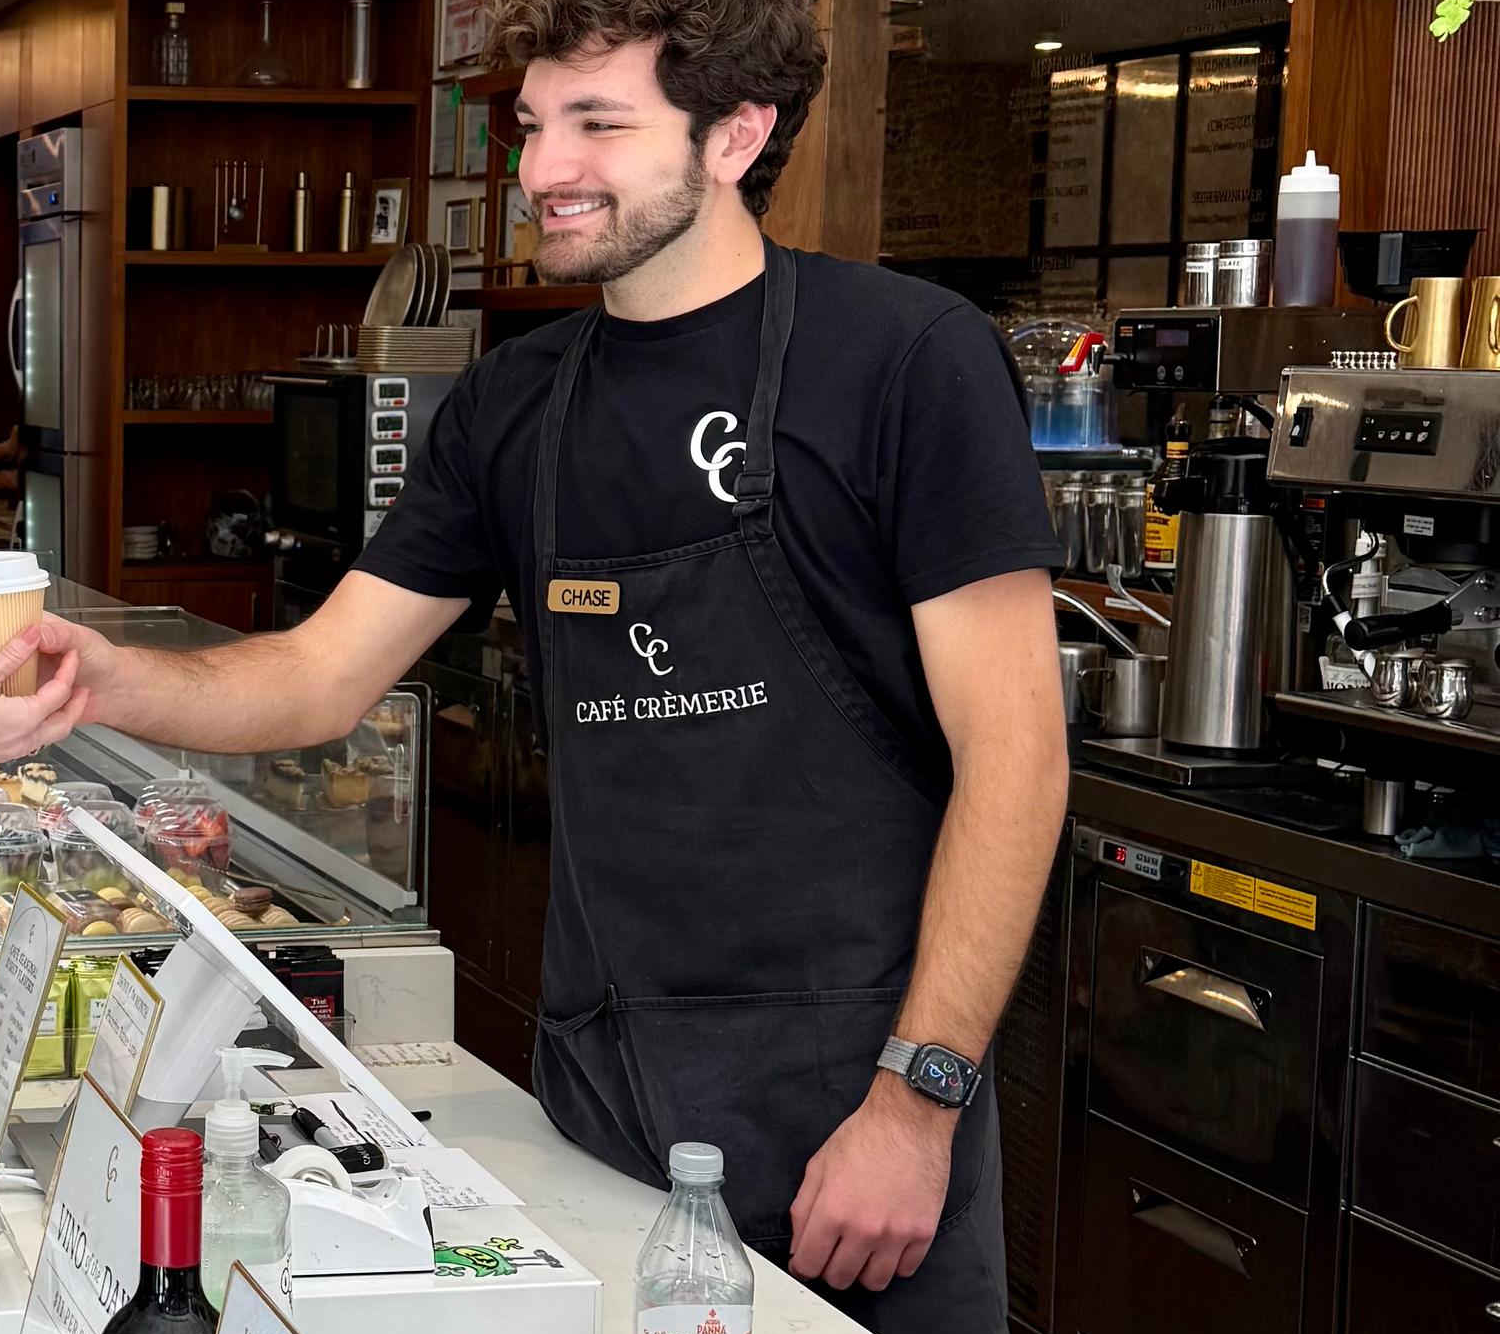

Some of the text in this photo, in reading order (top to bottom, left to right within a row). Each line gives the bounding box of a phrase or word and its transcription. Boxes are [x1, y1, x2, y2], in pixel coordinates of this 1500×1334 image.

[561, 588, 612, 608] CHASE
[576, 681, 768, 724] CAFÉ CRÈMERIE
[56, 1202, 88, 1270] VINO
